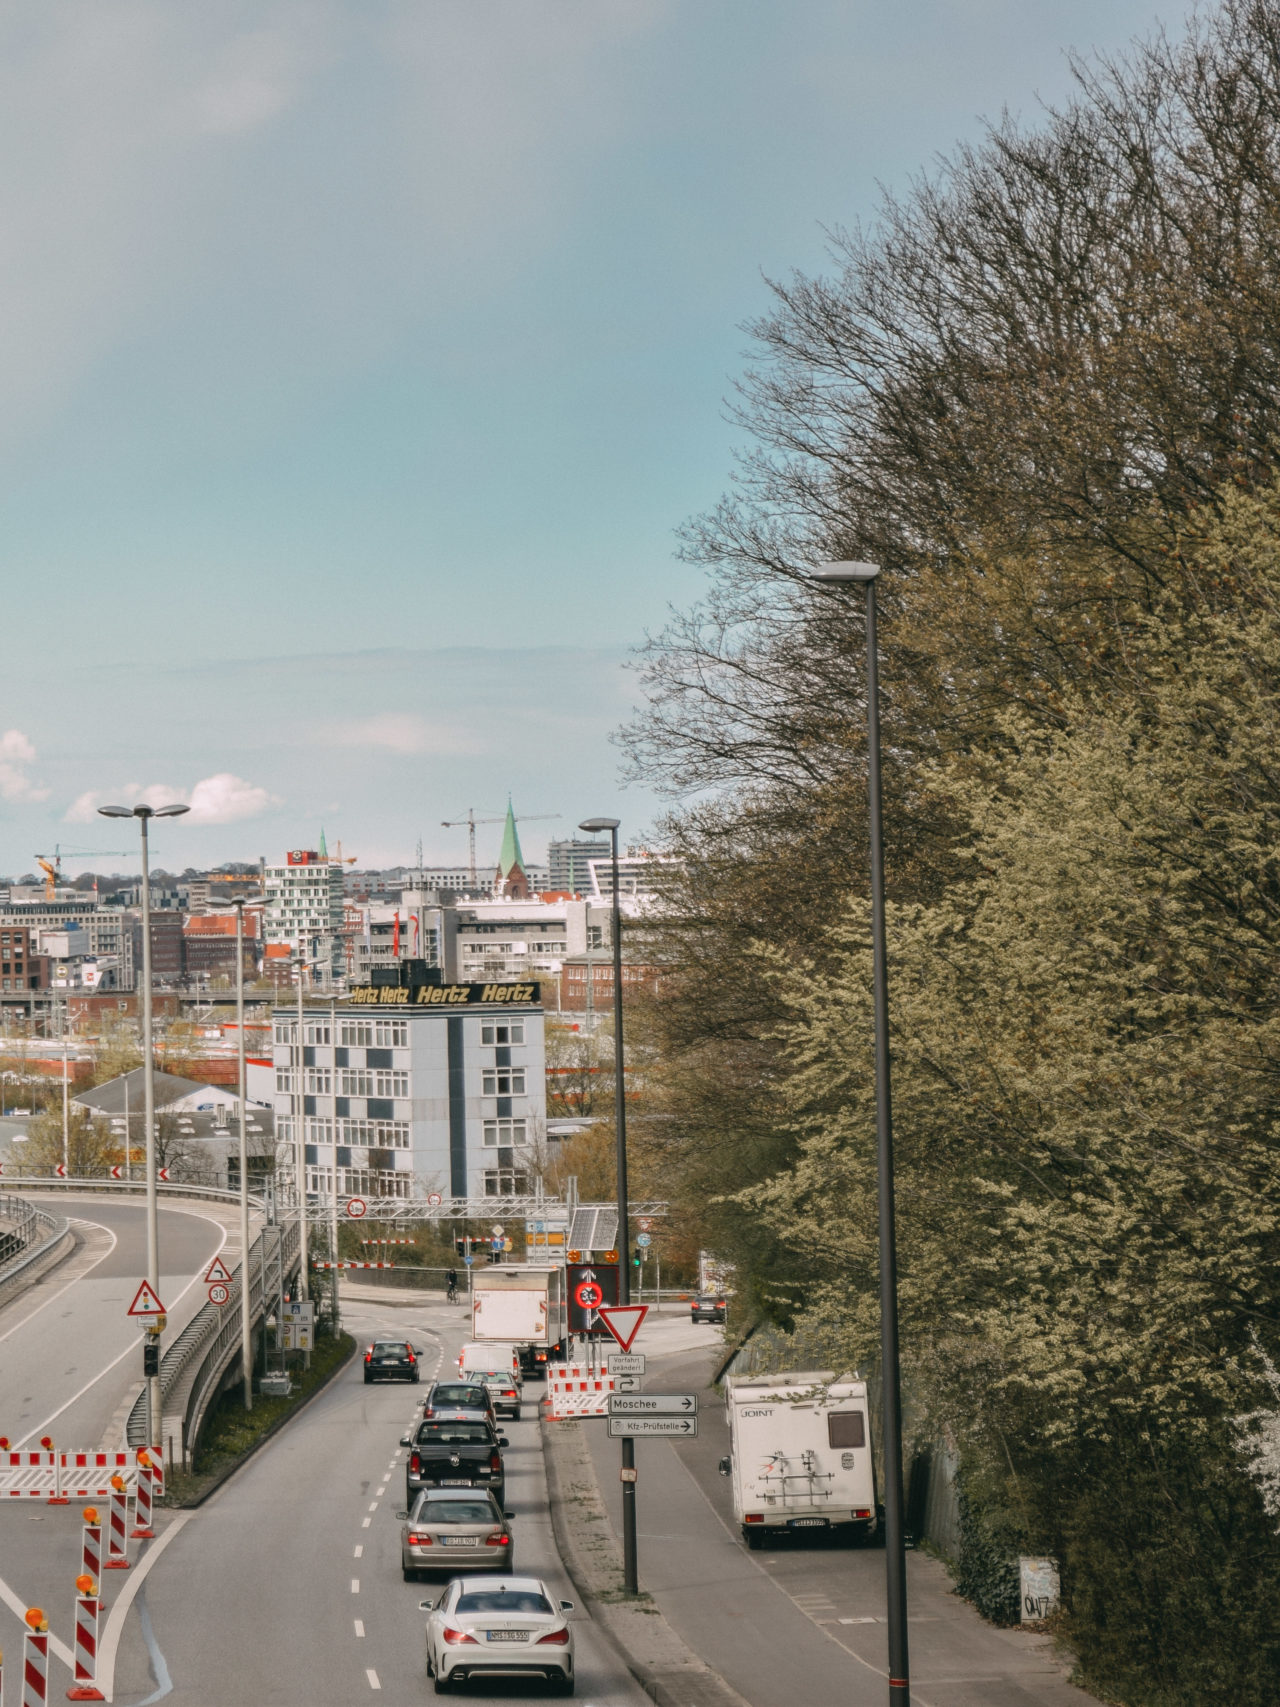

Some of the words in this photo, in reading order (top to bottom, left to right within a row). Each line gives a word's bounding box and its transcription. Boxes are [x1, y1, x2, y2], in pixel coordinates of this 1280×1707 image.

[380, 986, 409, 1004] Hertz
[418, 985, 471, 1004] Hertz
[481, 984, 535, 1002] Hertz
[213, 1289, 225, 1300] 30
[613, 1400, 657, 1409] Moschee
[741, 1409, 775, 1418] JOINT
[627, 1422, 680, 1431] Kfz-Prüfstelle
